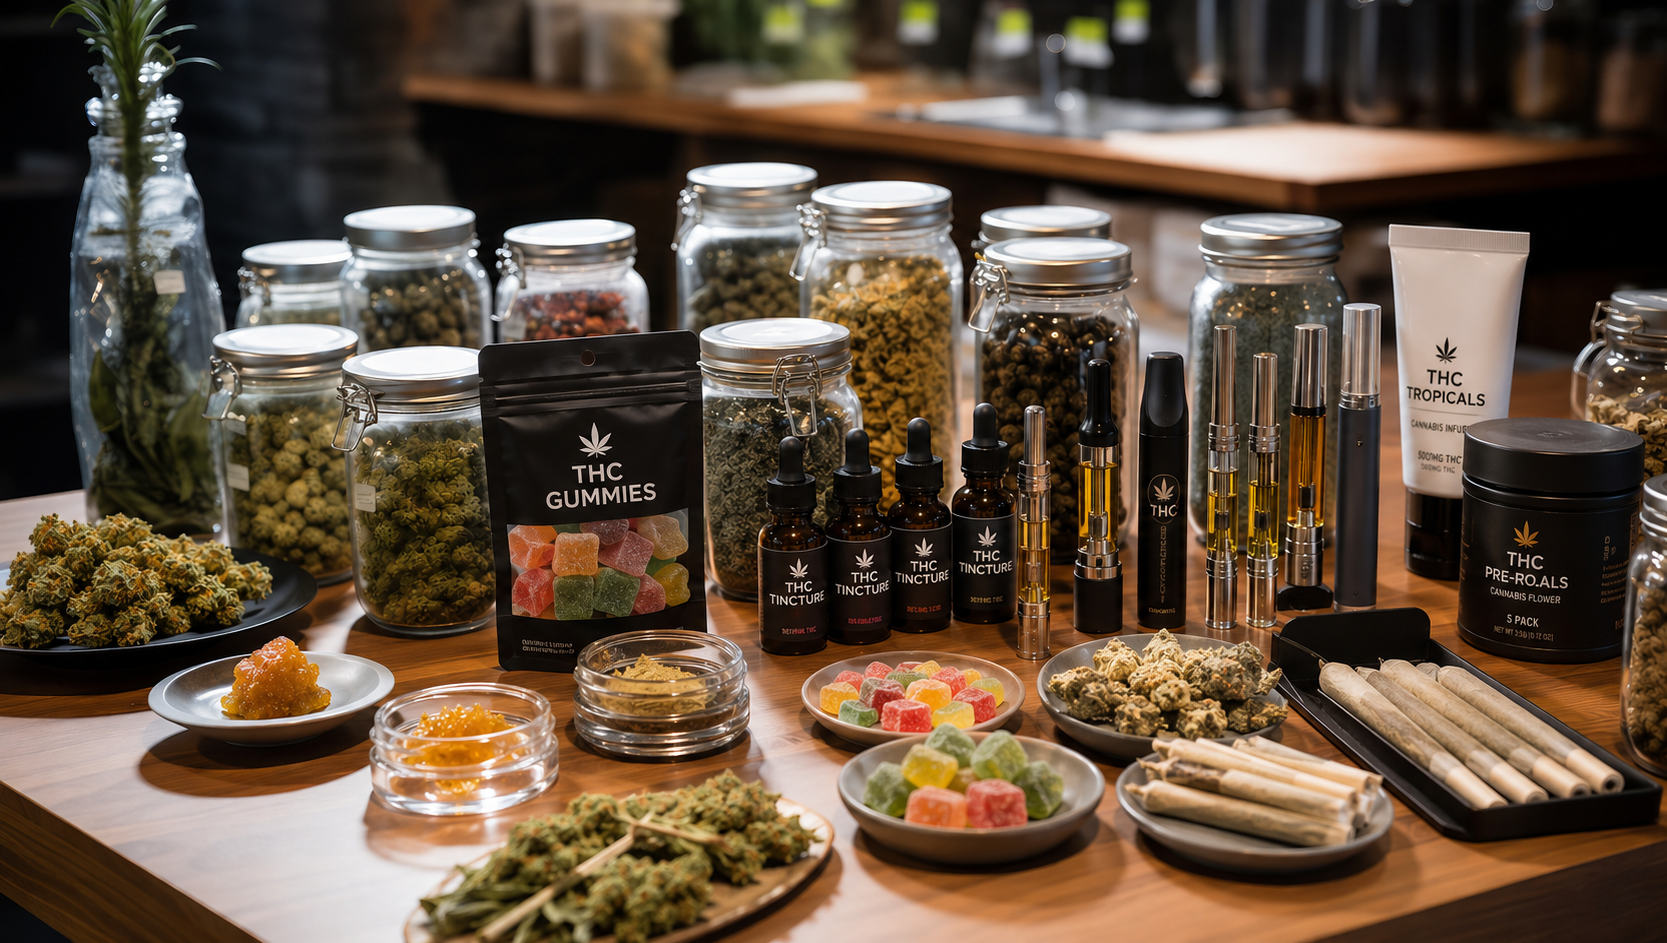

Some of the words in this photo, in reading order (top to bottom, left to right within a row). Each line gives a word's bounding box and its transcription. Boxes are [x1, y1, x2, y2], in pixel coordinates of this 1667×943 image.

[1427, 369, 1463, 387] THC
[1406, 386, 1486, 407] TROPICALS
[1411, 419, 1444, 432] CANNABIS
[1445, 454, 1462, 465] THC
[571, 462, 624, 484] THC
[545, 482, 657, 510] GUMMIES
[1150, 504, 1178, 518] THC
[973, 550, 1000, 562] THC
[1507, 551, 1544, 571] THC
[910, 560, 938, 572] THC
[959, 560, 1013, 575] TINCTURE
[851, 570, 878, 583] THC
[895, 569, 950, 585] TINCTURE
[785, 580, 813, 593] THC
[835, 580, 890, 597] TINCTURE
[769, 590, 826, 606] TINCTURE
[1490, 586, 1527, 602] CANNABIS
[1528, 593, 1561, 605] FLOWER
[1514, 615, 1540, 628] PACK
